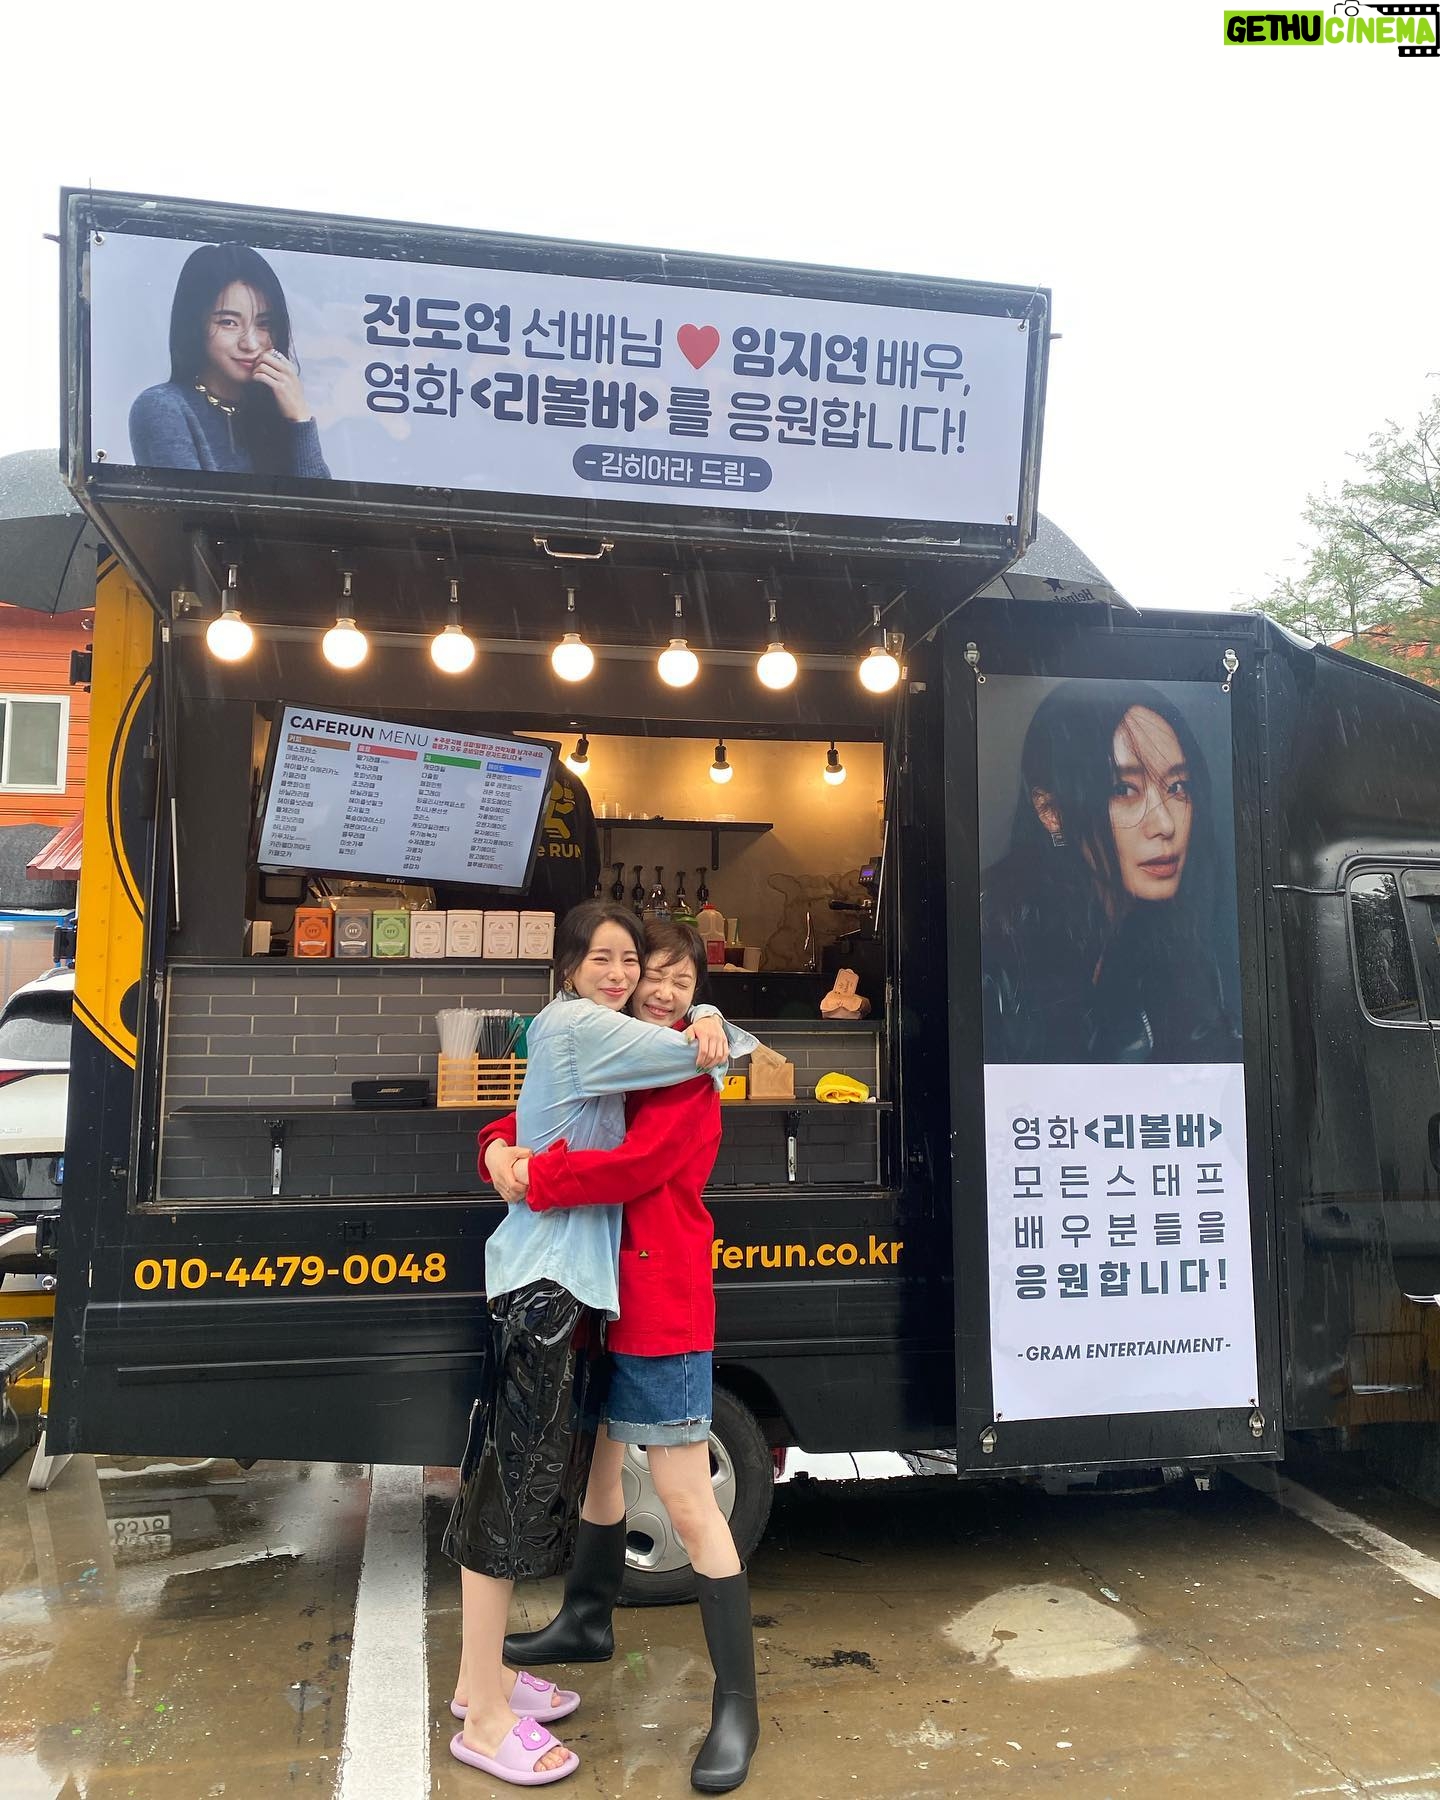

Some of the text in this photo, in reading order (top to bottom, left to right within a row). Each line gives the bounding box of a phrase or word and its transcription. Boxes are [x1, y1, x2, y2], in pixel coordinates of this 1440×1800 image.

[364, 294, 970, 396] 전도연 선배님 임지연 배우,
[728, 392, 966, 455] 응원합니다!
[290, 715, 428, 747] CAFERUN MENU
[135, 1253, 446, 1289] 010-4479-0048
[1016, 1259, 1226, 1299] 응원합니다!
